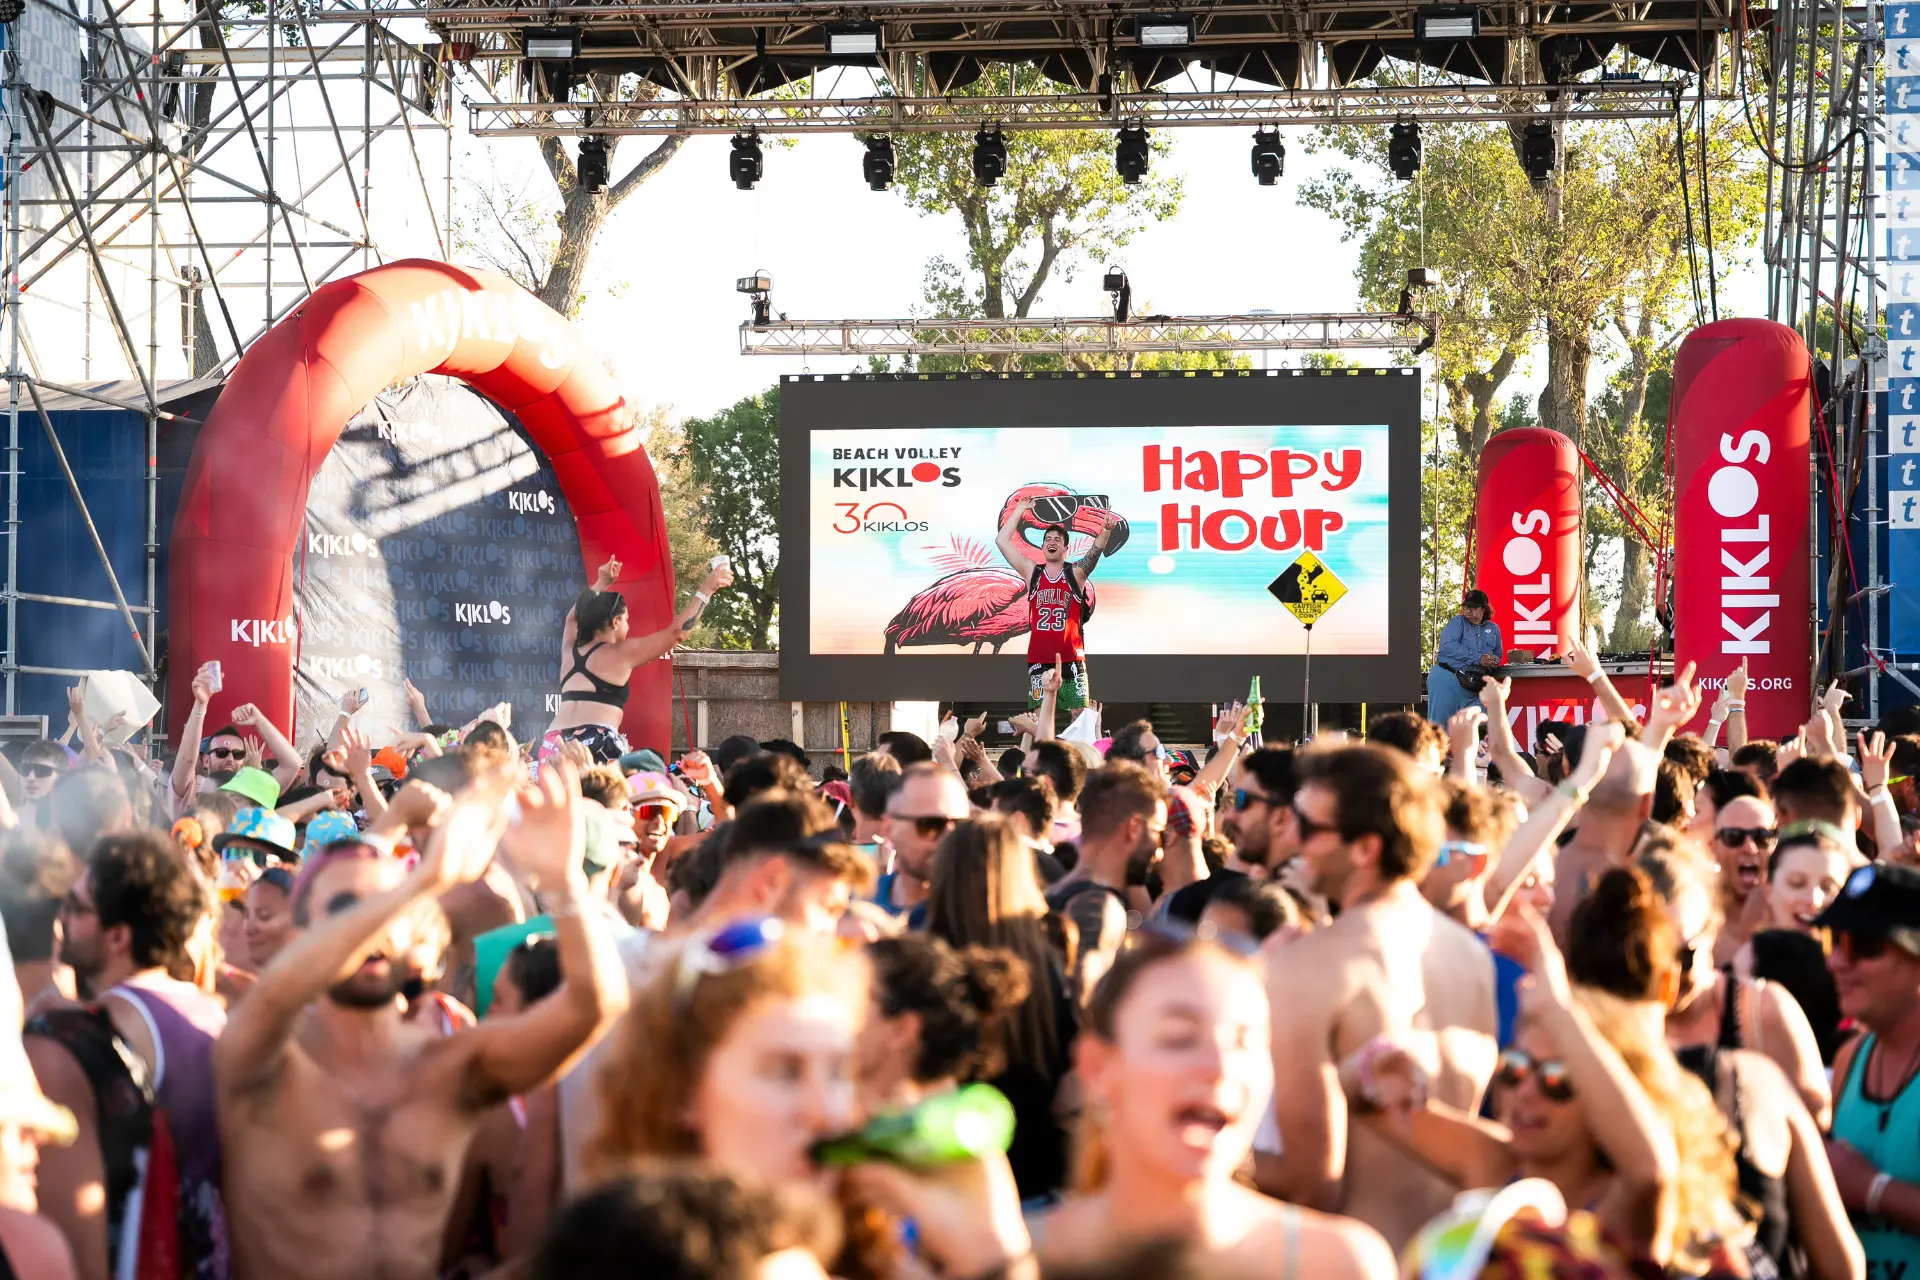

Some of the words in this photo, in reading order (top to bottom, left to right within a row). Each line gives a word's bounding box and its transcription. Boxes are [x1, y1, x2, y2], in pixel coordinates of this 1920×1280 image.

[833, 448, 888, 460] BEACH
[895, 447, 962, 460] VOLLEY
[834, 462, 962, 492] KIKLOS
[1143, 444, 1362, 498] Happy
[509, 490, 554, 514] KIKLOS
[482, 516, 533, 540] KIKLOS
[864, 522, 929, 532] KIKLOS
[1162, 503, 1343, 552] Hour
[309, 532, 378, 558] KIKLOS
[452, 542, 506, 567] KIKLOS
[1708, 430, 1780, 654] KIKLOS
[512, 548, 558, 572] KIKLOS
[421, 569, 480, 594] KIKLOS
[484, 573, 534, 598] KIKLOS
[1036, 588, 1071, 609] BULLS
[455, 600, 510, 626] KIKLOS
[1036, 608, 1066, 632] 23
[424, 629, 483, 654] KIKLOS
[488, 631, 539, 656] KIKLOS
[310, 654, 382, 680] KIKLOS
[458, 659, 514, 682] KIKLOS
[428, 687, 485, 711] KIKLOS
